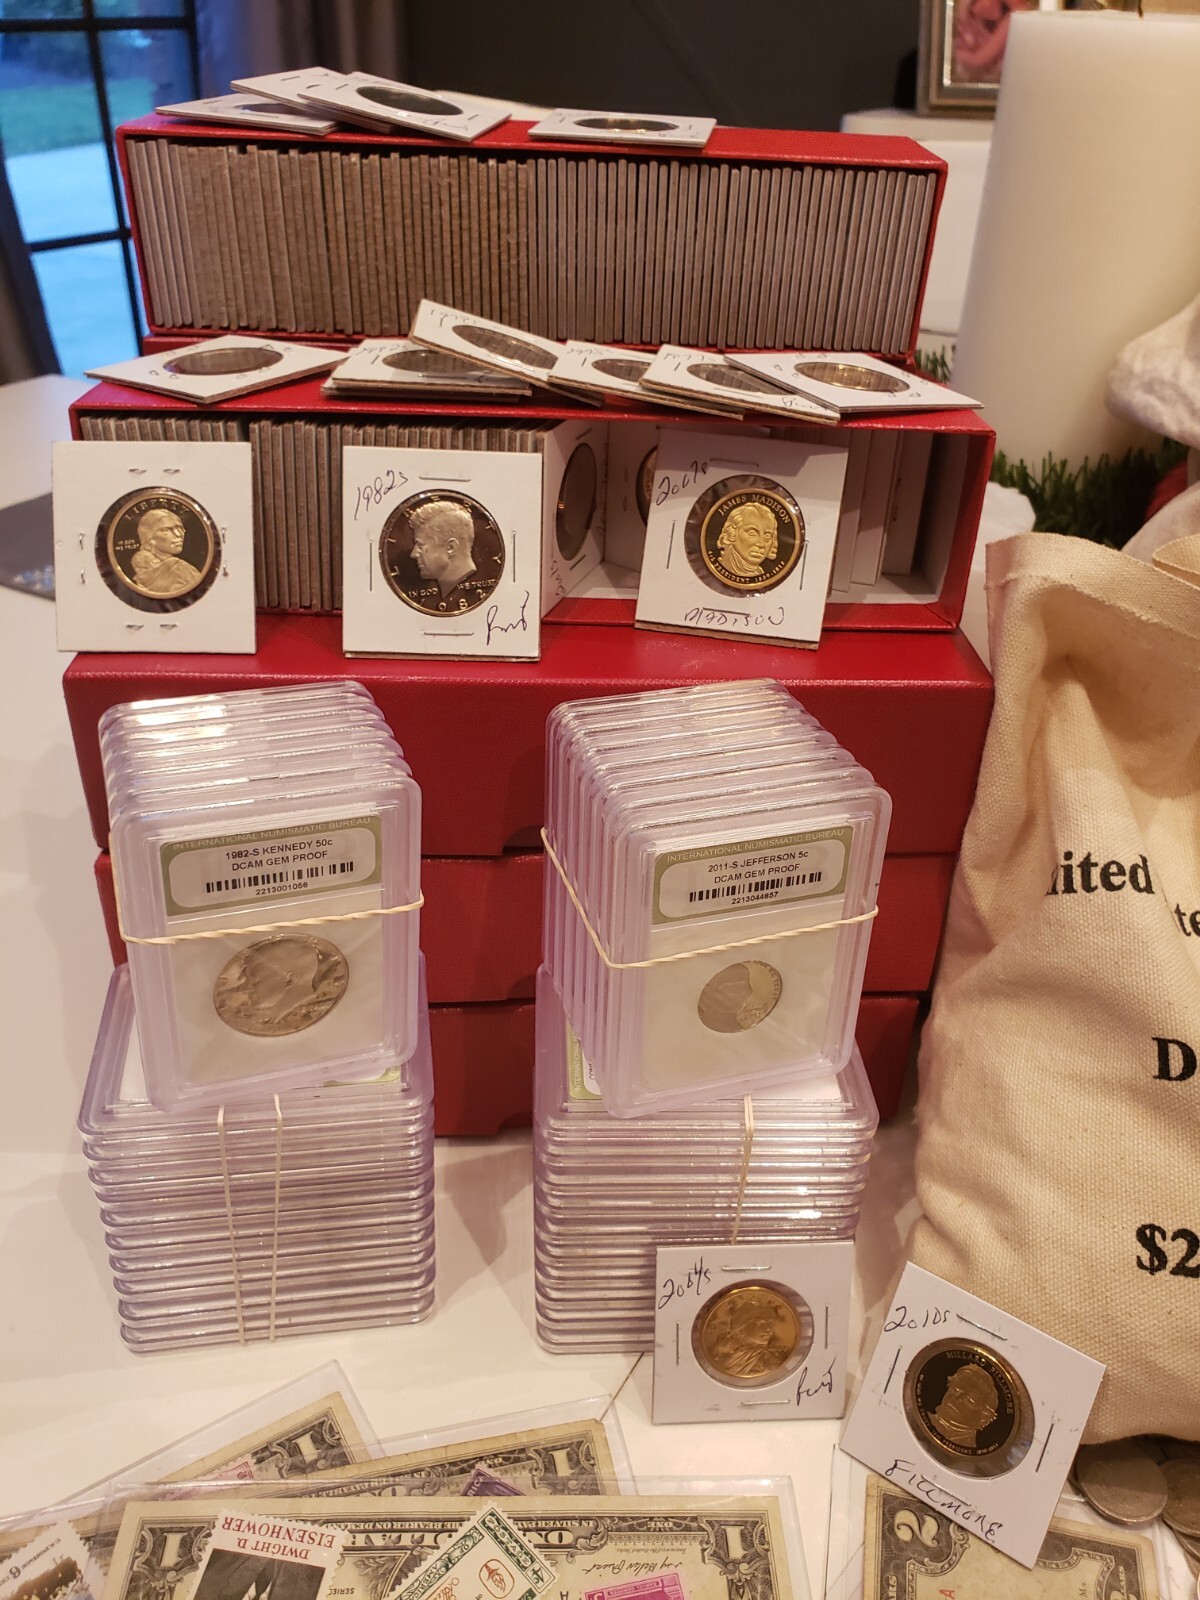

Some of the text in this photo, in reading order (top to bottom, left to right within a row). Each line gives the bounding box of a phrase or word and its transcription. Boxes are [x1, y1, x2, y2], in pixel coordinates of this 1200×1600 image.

[717, 494, 791, 524] JAMES MADISON
[471, 578, 497, 588] TRUST
[172, 816, 372, 851] INTERNATIONAL NUMISMATIC BUREAU
[666, 828, 845, 863] INTERNATIONAL NUMISMATIC BUREAU
[225, 847, 260, 861] 1982-S
[263, 839, 314, 855] KENNEDY
[231, 850, 329, 872] DCAM GEM PROOF
[708, 860, 739, 873] 2011-S
[740, 851, 796, 868] JEFFERSON
[714, 863, 801, 884] DCAM GEM PROOF
[1135, 1223, 1200, 1279] $2
[221, 1516, 337, 1549] EISENHOWER
[538, 1520, 580, 1528] SILVER
[647, 1520, 675, 1528] ONE
[893, 1509, 941, 1548] 2
[159, 1531, 191, 1569] 1
[237, 1537, 312, 1560] DWIGHT D.
[484, 1514, 532, 1568] POSTAGE
[722, 1523, 750, 1562] 1
